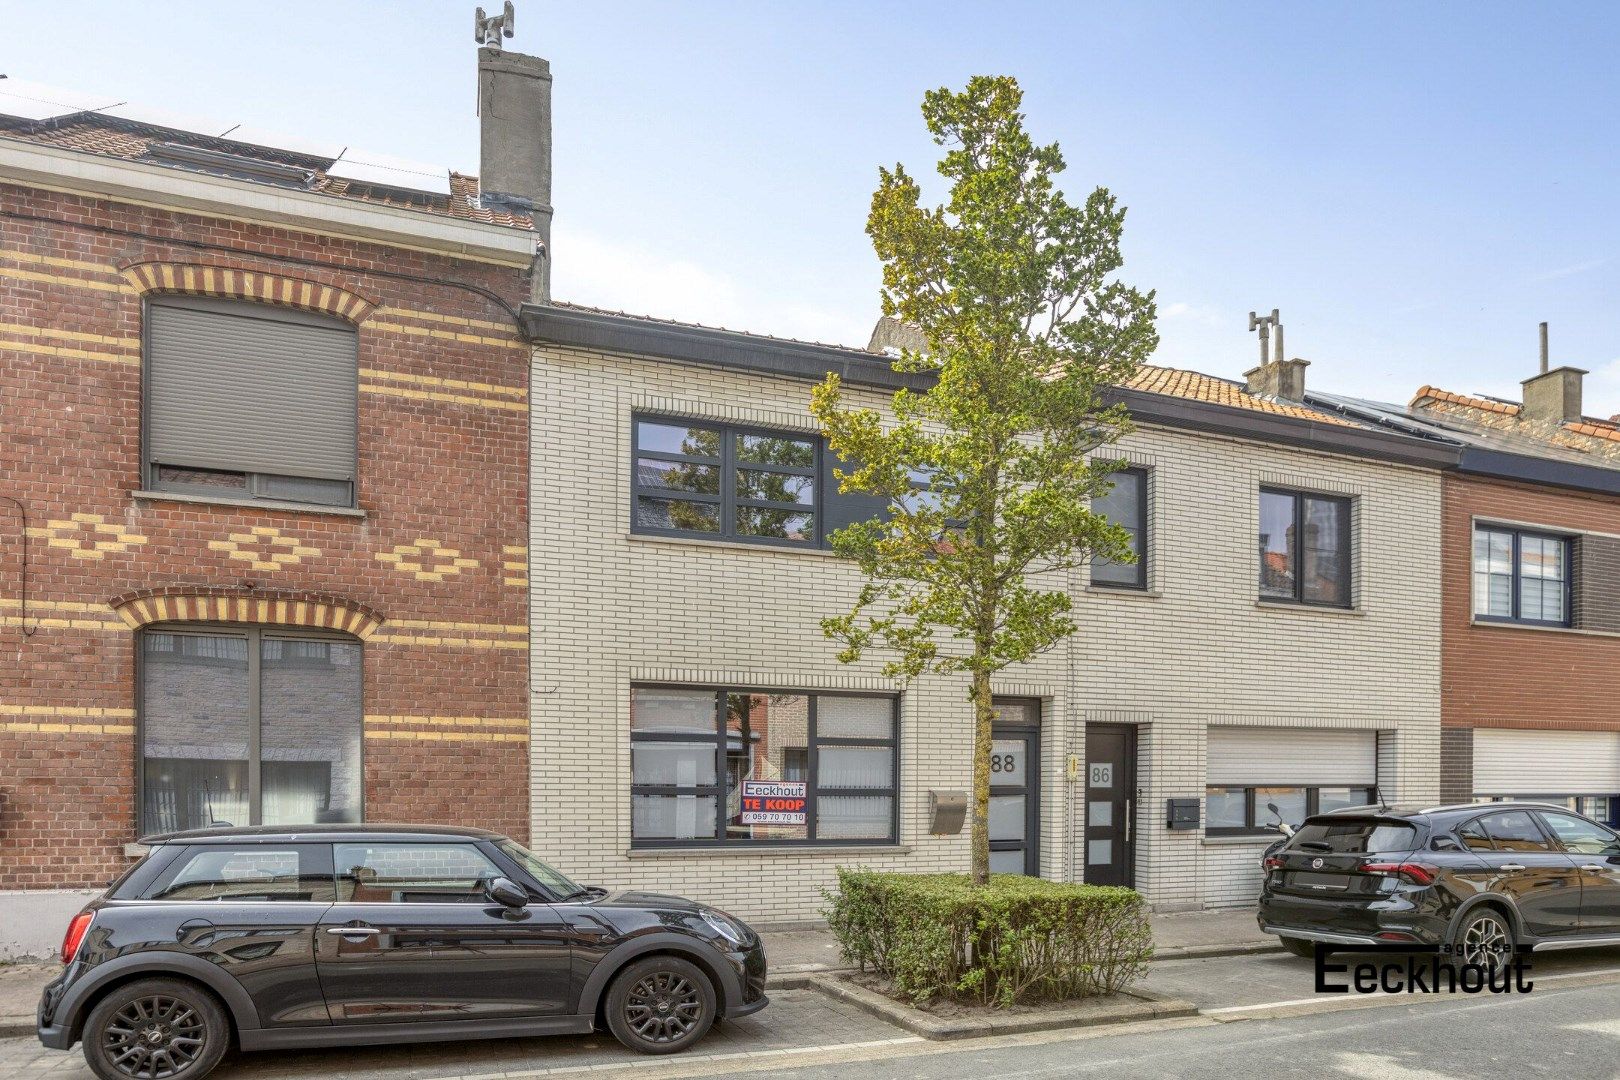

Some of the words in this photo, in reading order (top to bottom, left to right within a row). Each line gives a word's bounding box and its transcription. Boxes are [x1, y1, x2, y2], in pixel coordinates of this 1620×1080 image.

[991, 755, 1015, 772] 88
[1092, 767, 1110, 783] 86
[745, 782, 804, 796] Eeckhout
[744, 799, 761, 811] TE
[765, 799, 805, 811] KOOP
[752, 813, 768, 821] 059
[770, 813, 780, 821] 70
[782, 813, 792, 821] 70
[794, 813, 804, 821] 10
